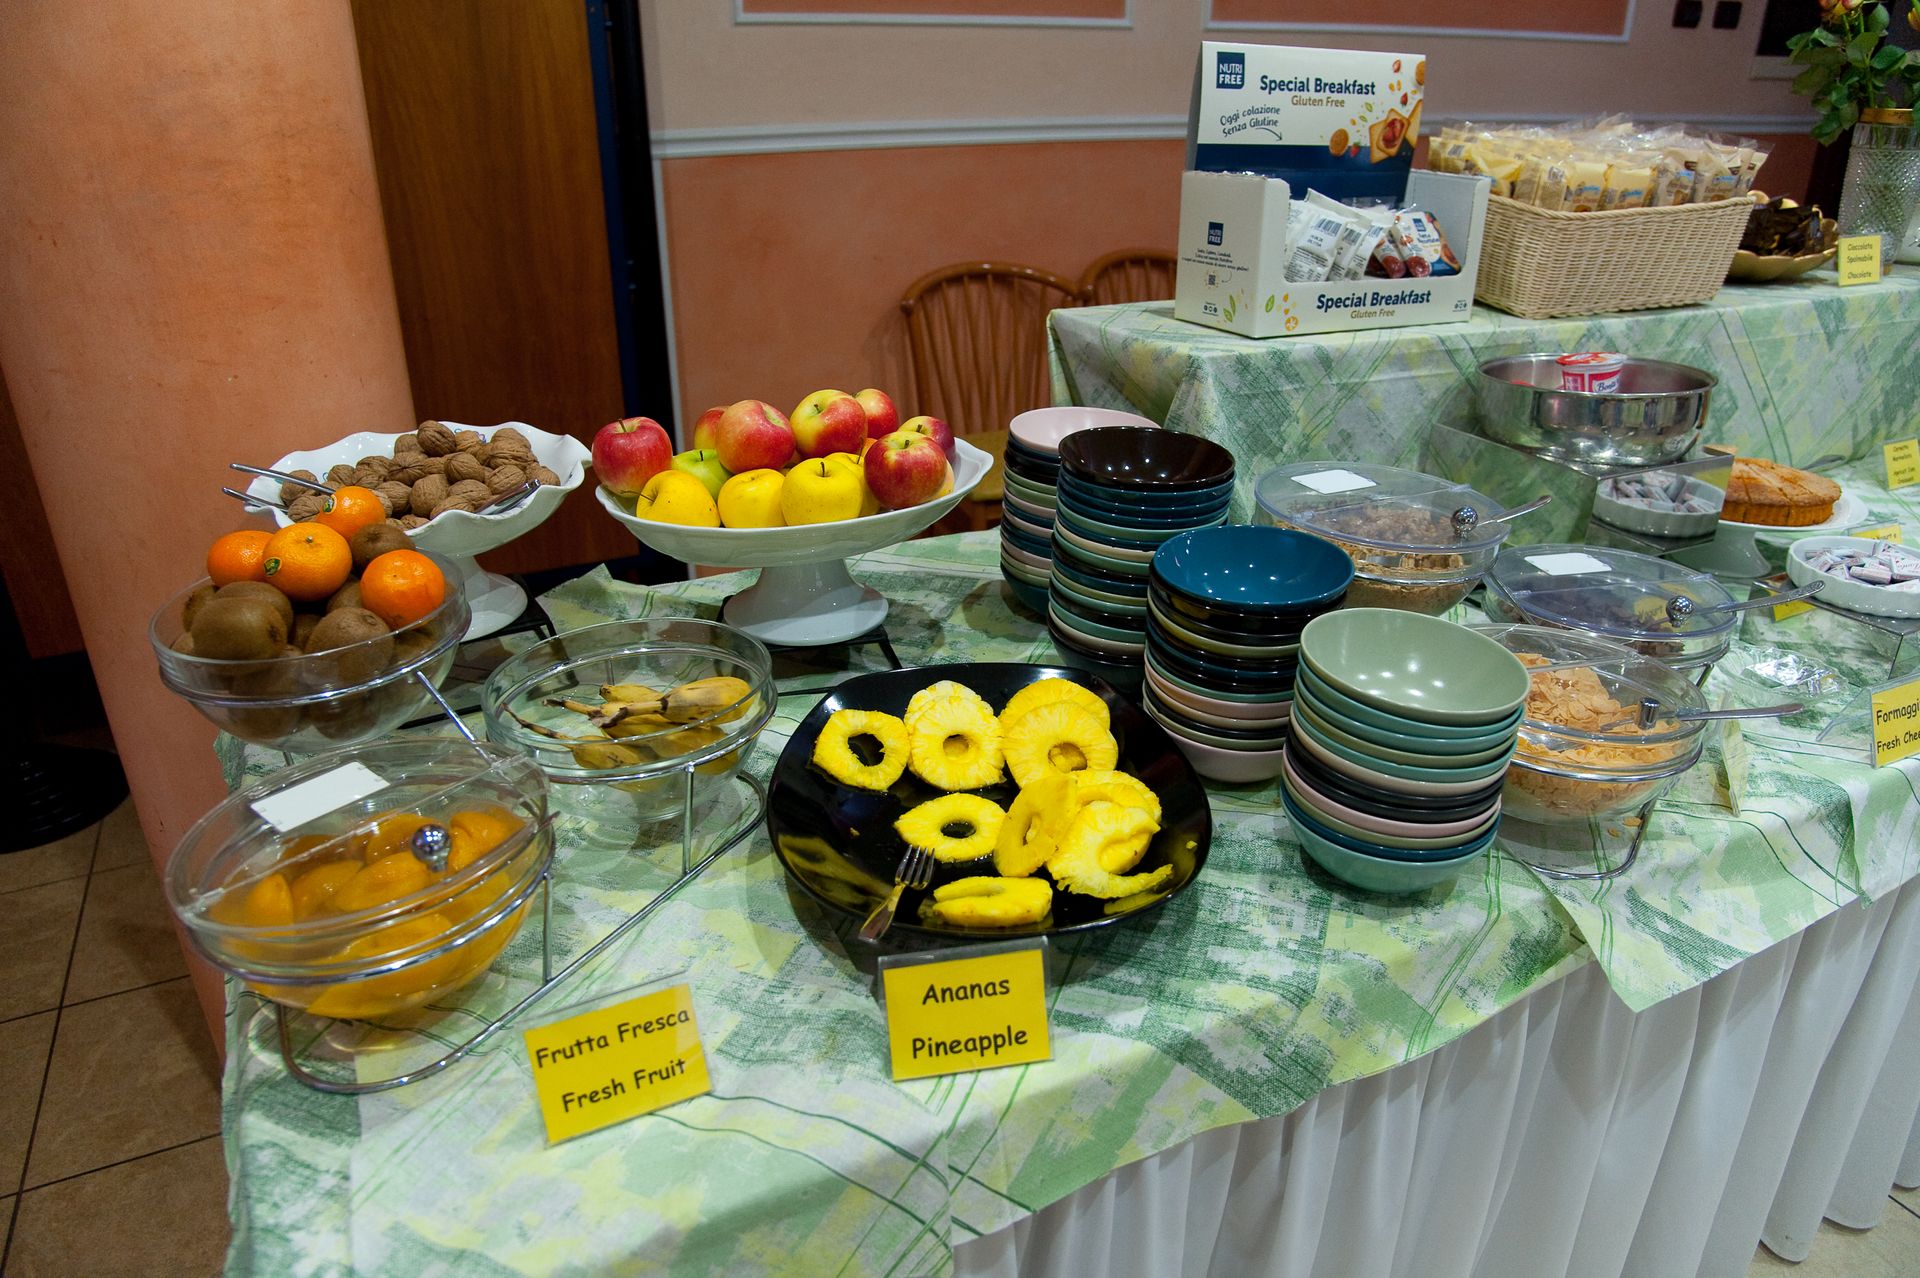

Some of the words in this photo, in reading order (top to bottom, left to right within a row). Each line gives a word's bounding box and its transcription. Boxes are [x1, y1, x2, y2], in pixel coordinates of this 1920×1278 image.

[1219, 63, 1243, 74] NUTRI
[1218, 74, 1243, 85] FREE
[1260, 75, 1310, 94] Special
[1314, 78, 1376, 95] Breakfast
[1291, 95, 1323, 107] Gluten
[1326, 96, 1345, 108] Free
[1220, 109, 1240, 126] Oggi
[1242, 105, 1281, 117] colazione
[1222, 123, 1247, 138] Senza
[1249, 117, 1280, 128] Glutine
[1316, 292, 1367, 313] Special
[1370, 289, 1431, 308] Breakfast
[1350, 308, 1377, 319] Gluten
[1379, 308, 1396, 317] Free
[1876, 699, 1920, 726] Formaggi
[1876, 735, 1900, 754] Fresh
[922, 979, 1010, 1005] Ananas
[535, 1035, 610, 1069] Frutta
[617, 1009, 690, 1043] Fresca
[912, 1025, 1028, 1059] Pineapple
[562, 1078, 626, 1113] Fresh
[633, 1058, 686, 1089] Fruit
